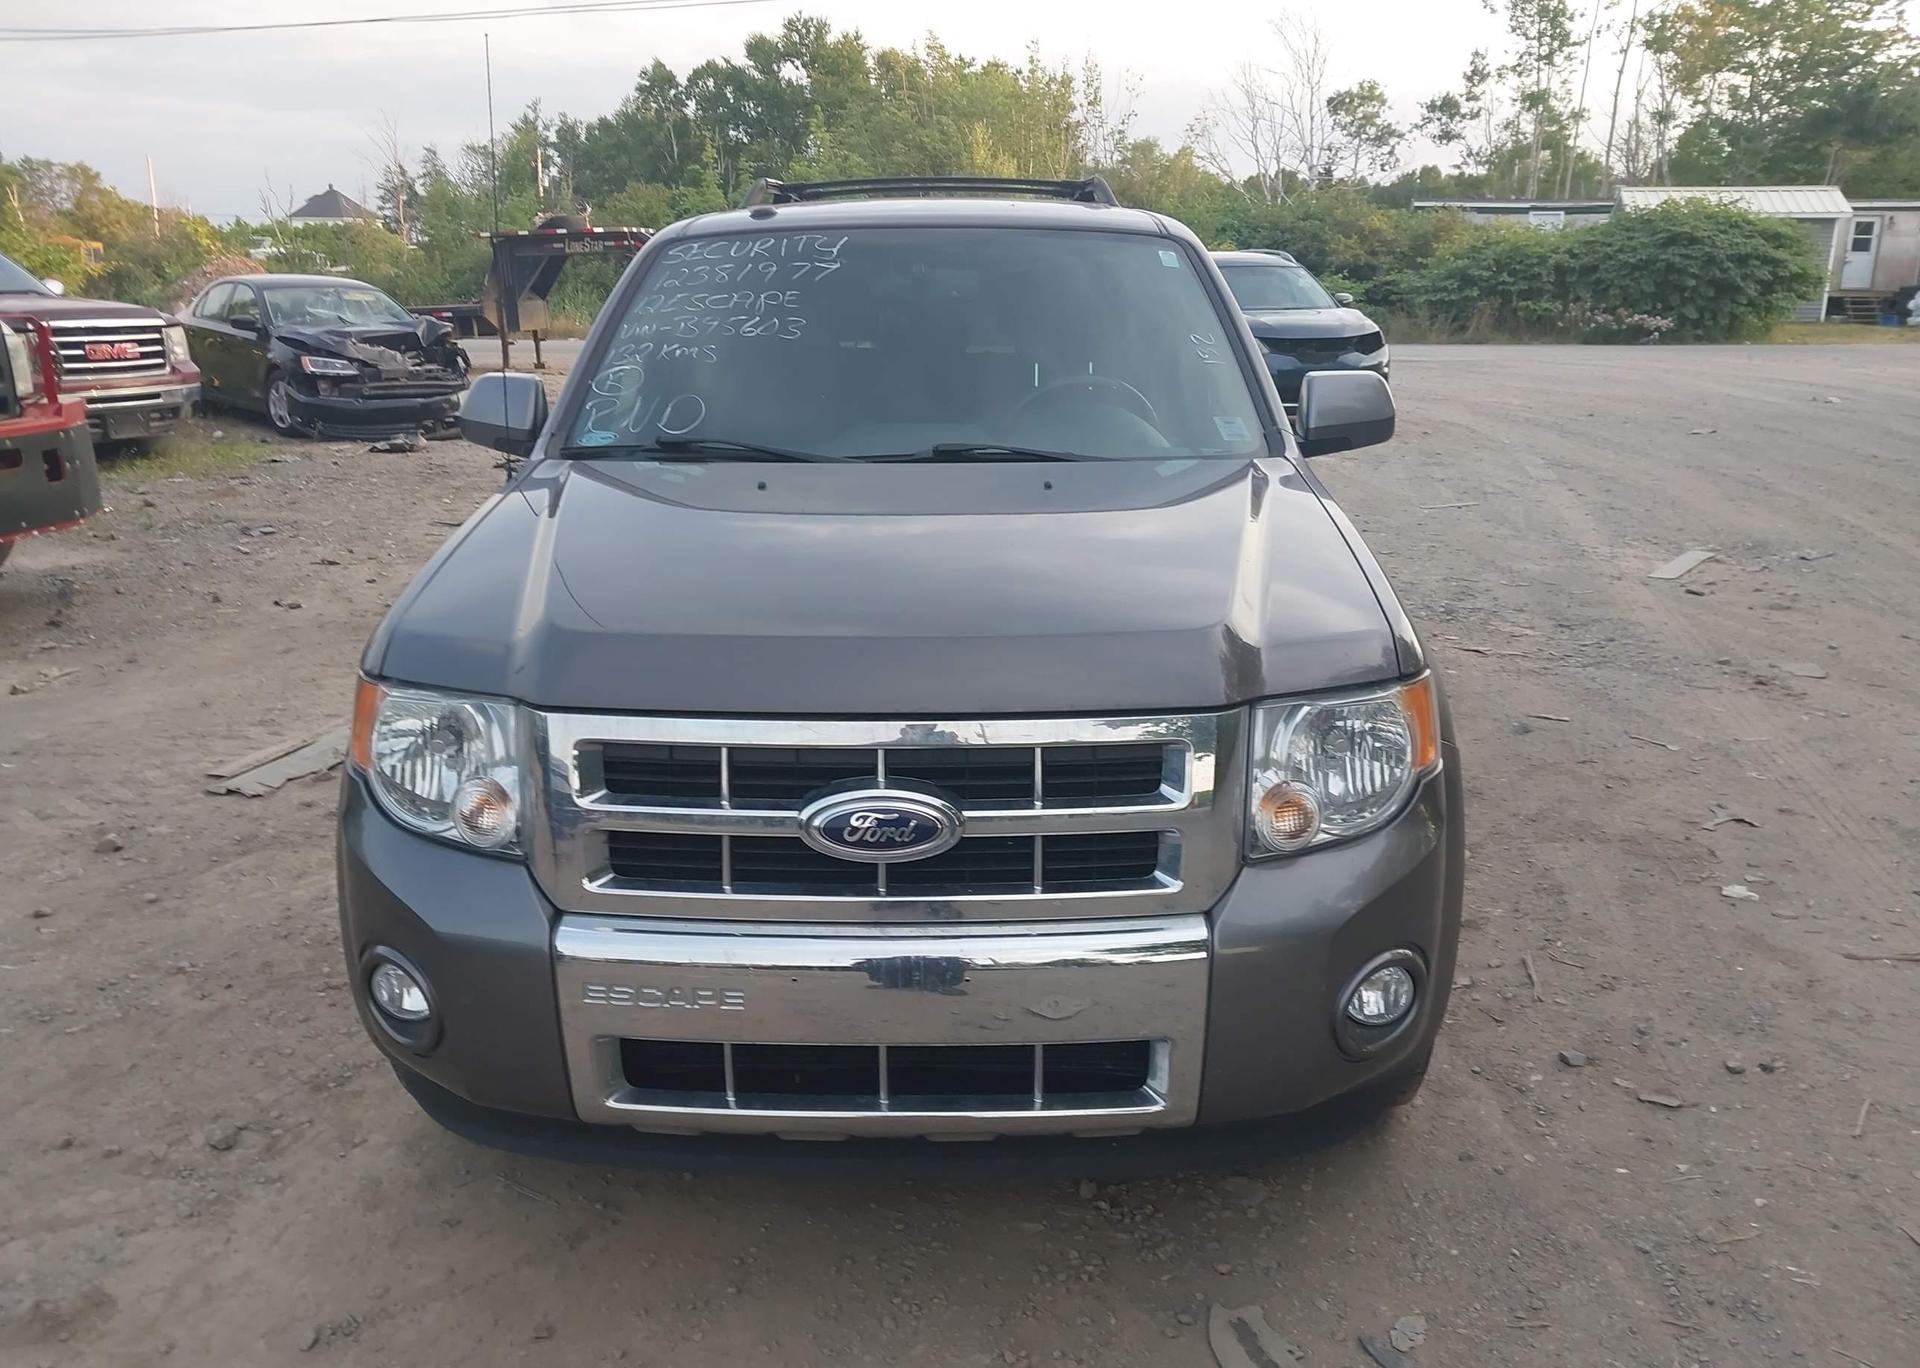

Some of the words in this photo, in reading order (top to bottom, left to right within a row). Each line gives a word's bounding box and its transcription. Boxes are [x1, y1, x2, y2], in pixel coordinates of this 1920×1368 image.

[660, 235, 848, 262] SECURITY
[653, 261, 842, 290] 12381977
[84, 342, 141, 361] GMC
[842, 811, 916, 843] Ford
[582, 984, 745, 1011] ESCAPE
